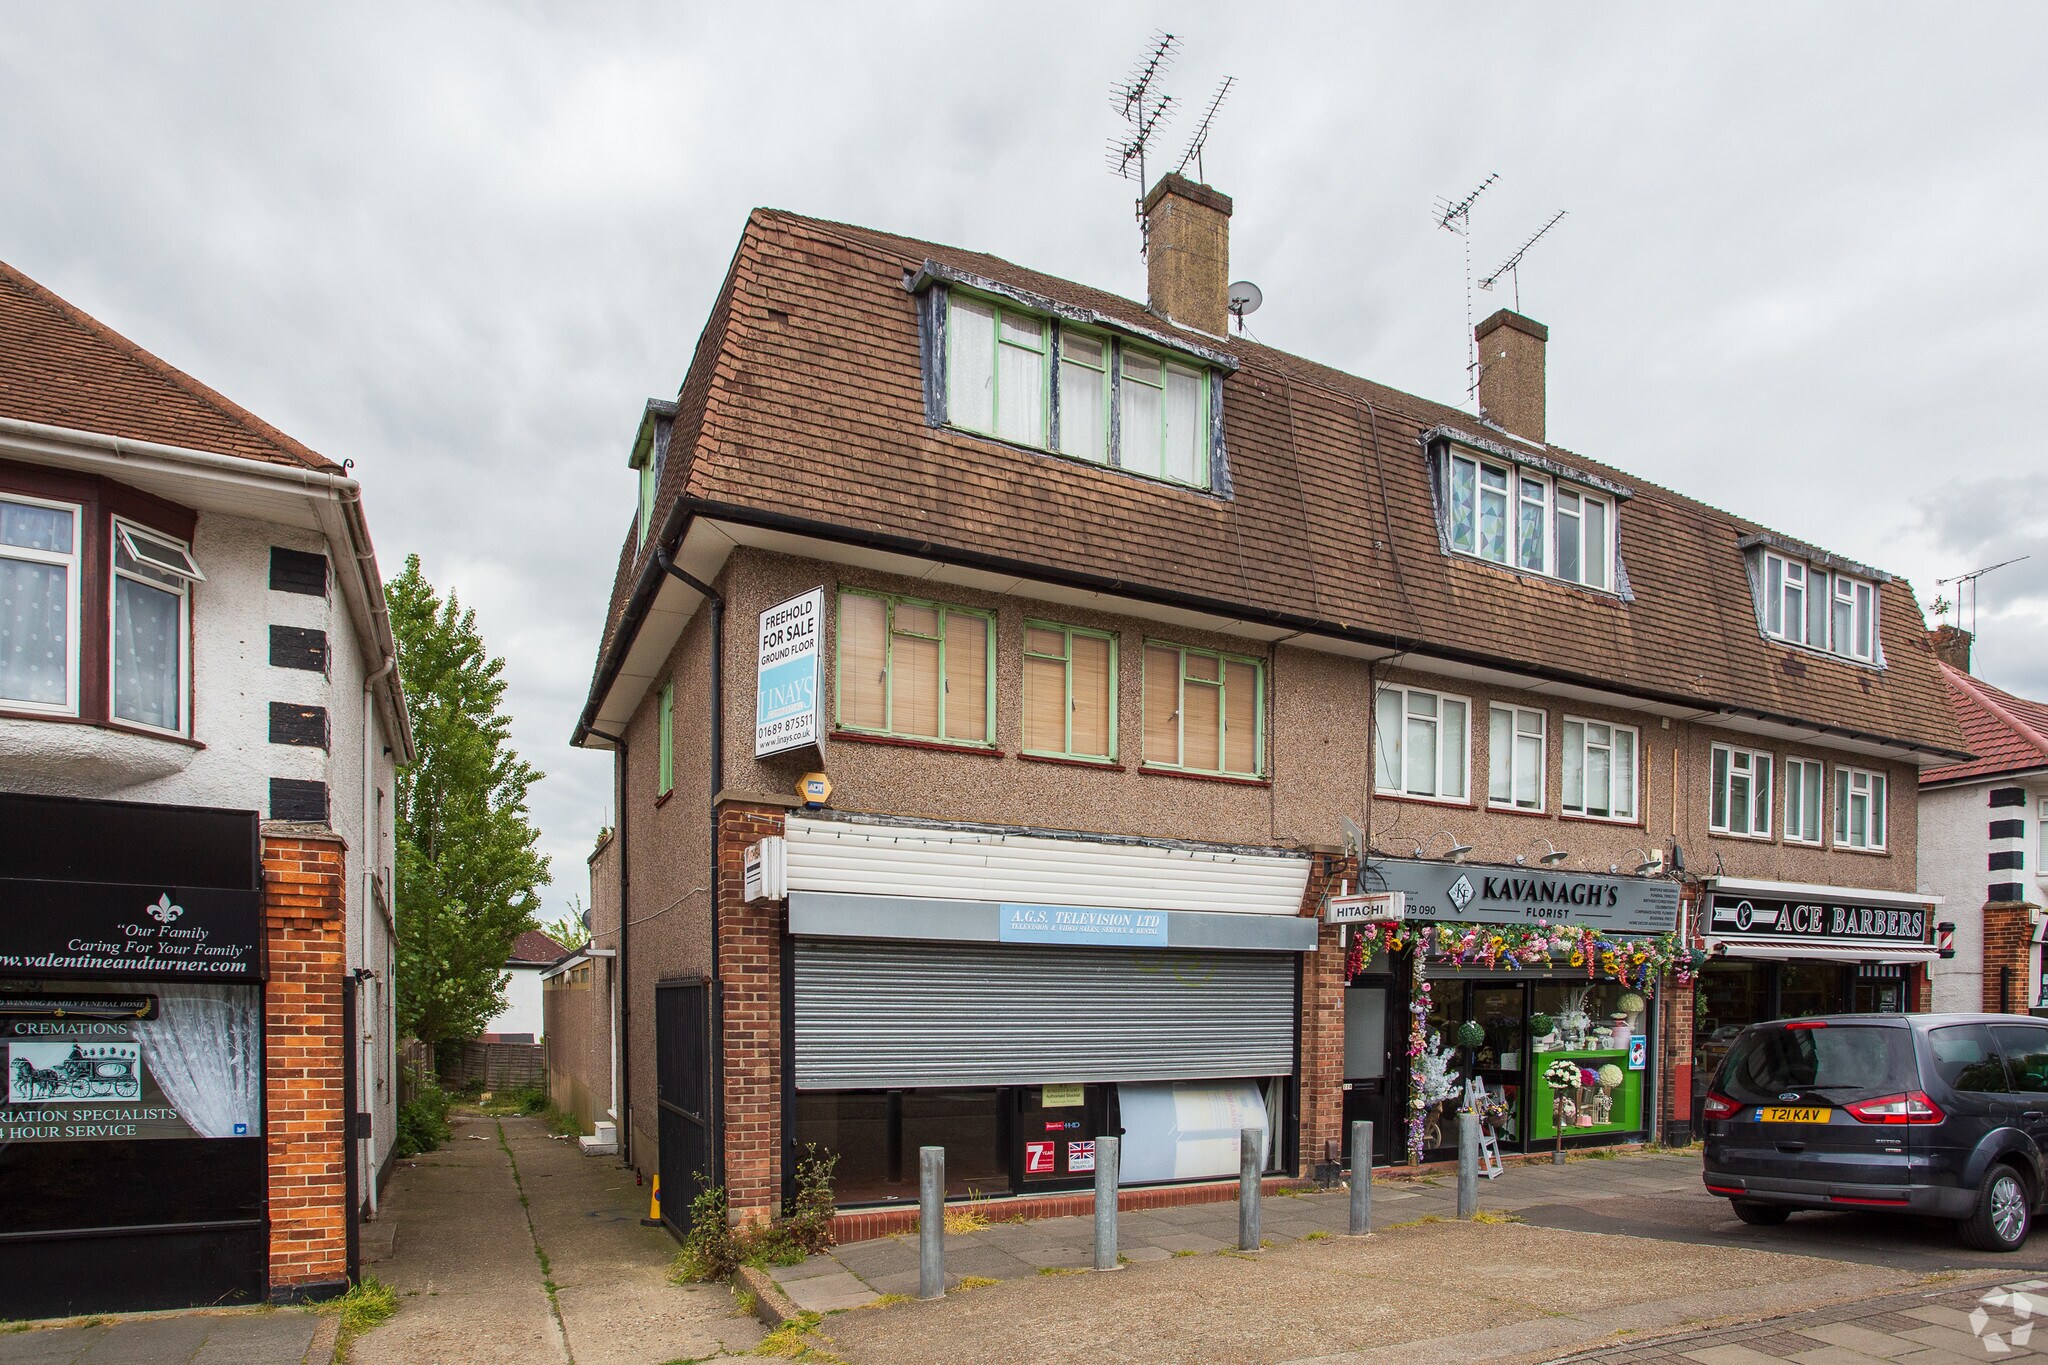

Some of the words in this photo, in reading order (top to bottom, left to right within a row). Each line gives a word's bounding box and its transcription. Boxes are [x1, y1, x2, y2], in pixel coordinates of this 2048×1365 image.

[765, 600, 813, 631] FREEHOLD
[763, 629, 784, 651] FOR
[786, 617, 814, 642] SALE
[761, 647, 790, 666] GROUND
[791, 638, 814, 655] FLOOR
[760, 675, 813, 722] LINAYS
[768, 702, 804, 719] COMMERCIAL
[758, 722, 782, 739] 01689
[785, 713, 813, 732] 875511
[759, 728, 810, 750] www.linays.co.uk
[808, 783, 824, 793] ADT
[1483, 876, 1618, 907] KAVANAGH'S
[1337, 905, 1383, 917] HITACHI
[1419, 905, 1436, 915] 090
[1526, 907, 1569, 919] FLORIST
[1011, 910, 1048, 923] A.G.S.
[1055, 912, 1132, 927] TELEVISION
[1136, 915, 1160, 928] LTD
[1011, 923, 1048, 931] TELEVISION
[1775, 904, 1823, 933] ACE
[1831, 907, 1922, 937] BARBERS
[158, 926, 209, 940] Family
[68, 938, 121, 955] Caring
[125, 940, 152, 954] For
[157, 942, 190, 955] Your
[15, 1022, 128, 1035] CREMATIONS
[73, 1108, 177, 1121] SPECIALISTS
[1771, 1109, 1791, 1120] T21
[1793, 1109, 1820, 1121] KAV
[10, 1126, 62, 1139] HOUR
[65, 1124, 137, 1138] SERVICE
[1028, 1145, 1043, 1170] 7
